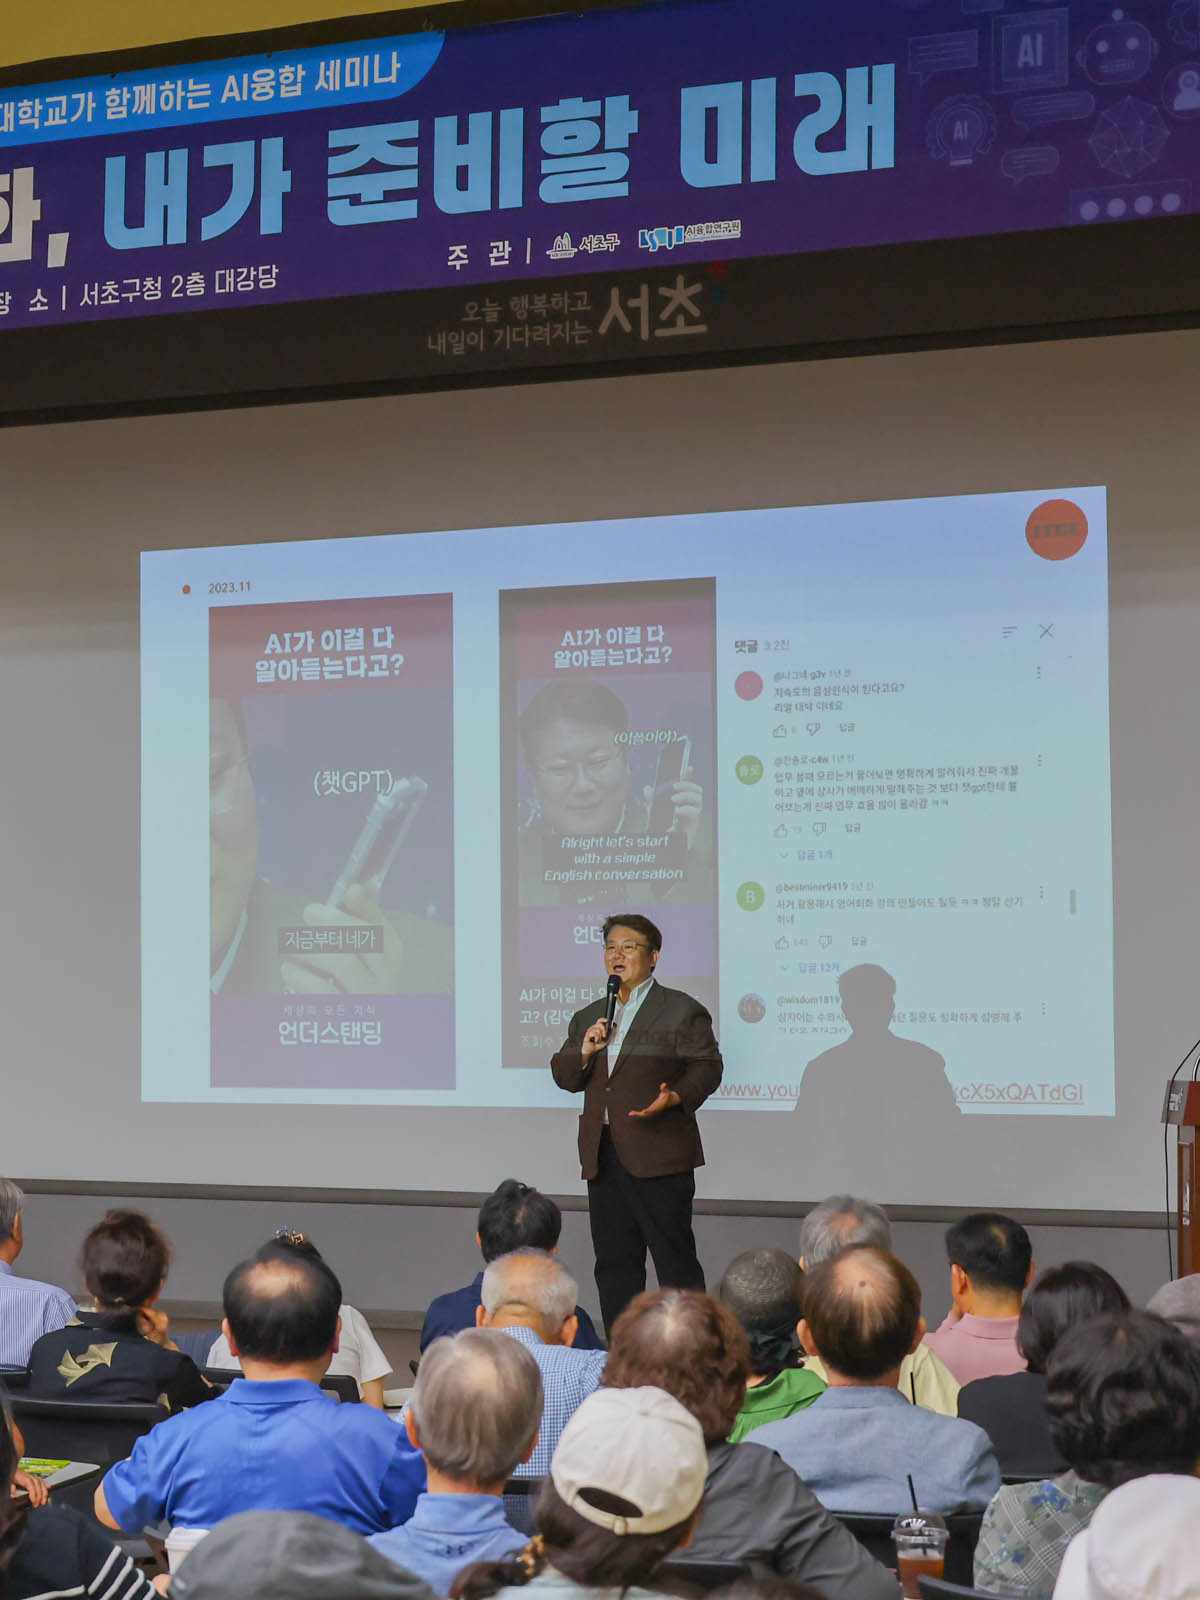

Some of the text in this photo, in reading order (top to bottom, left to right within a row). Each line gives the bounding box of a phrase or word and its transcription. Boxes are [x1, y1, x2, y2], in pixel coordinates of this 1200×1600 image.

[105, 77, 211, 121] 함께하는
[221, 63, 305, 104] AI융합
[314, 50, 401, 93] 세미나
[103, 136, 292, 251] 내가
[327, 94, 639, 227] 준비할
[680, 62, 896, 189] 미래
[447, 244, 469, 270] 주
[488, 240, 512, 266] 관
[579, 233, 621, 255] 서초구
[29, 291, 49, 313] 소
[79, 275, 163, 308] 서초구청
[170, 271, 207, 298] 2층
[214, 264, 280, 295] 대강당
[461, 290, 592, 323] 오늘 행복하고
[598, 273, 709, 342] 서초
[426, 319, 593, 356] 내일이 기다려지는
[208, 580, 251, 595] 2023.11
[264, 626, 394, 655] AI가 이걸 다
[562, 625, 665, 648] AI가 이걸 다
[734, 639, 758, 655] 댓글
[255, 653, 405, 684] 알아듣는다고?
[553, 645, 673, 670] 알아듣는다고?
[312, 768, 394, 797] (챗GPT)
[561, 835, 603, 850] Alright
[637, 835, 669, 847] start
[574, 853, 600, 865] with
[615, 852, 656, 866] simple
[545, 867, 684, 884] English conversation
[285, 928, 376, 952] 지금부터 네가
[519, 986, 547, 1003] AI가
[551, 986, 577, 1004] 이걸
[580, 986, 595, 1003] 다
[520, 1009, 540, 1025] 고?
[278, 1021, 382, 1045] 언더스탠딩
